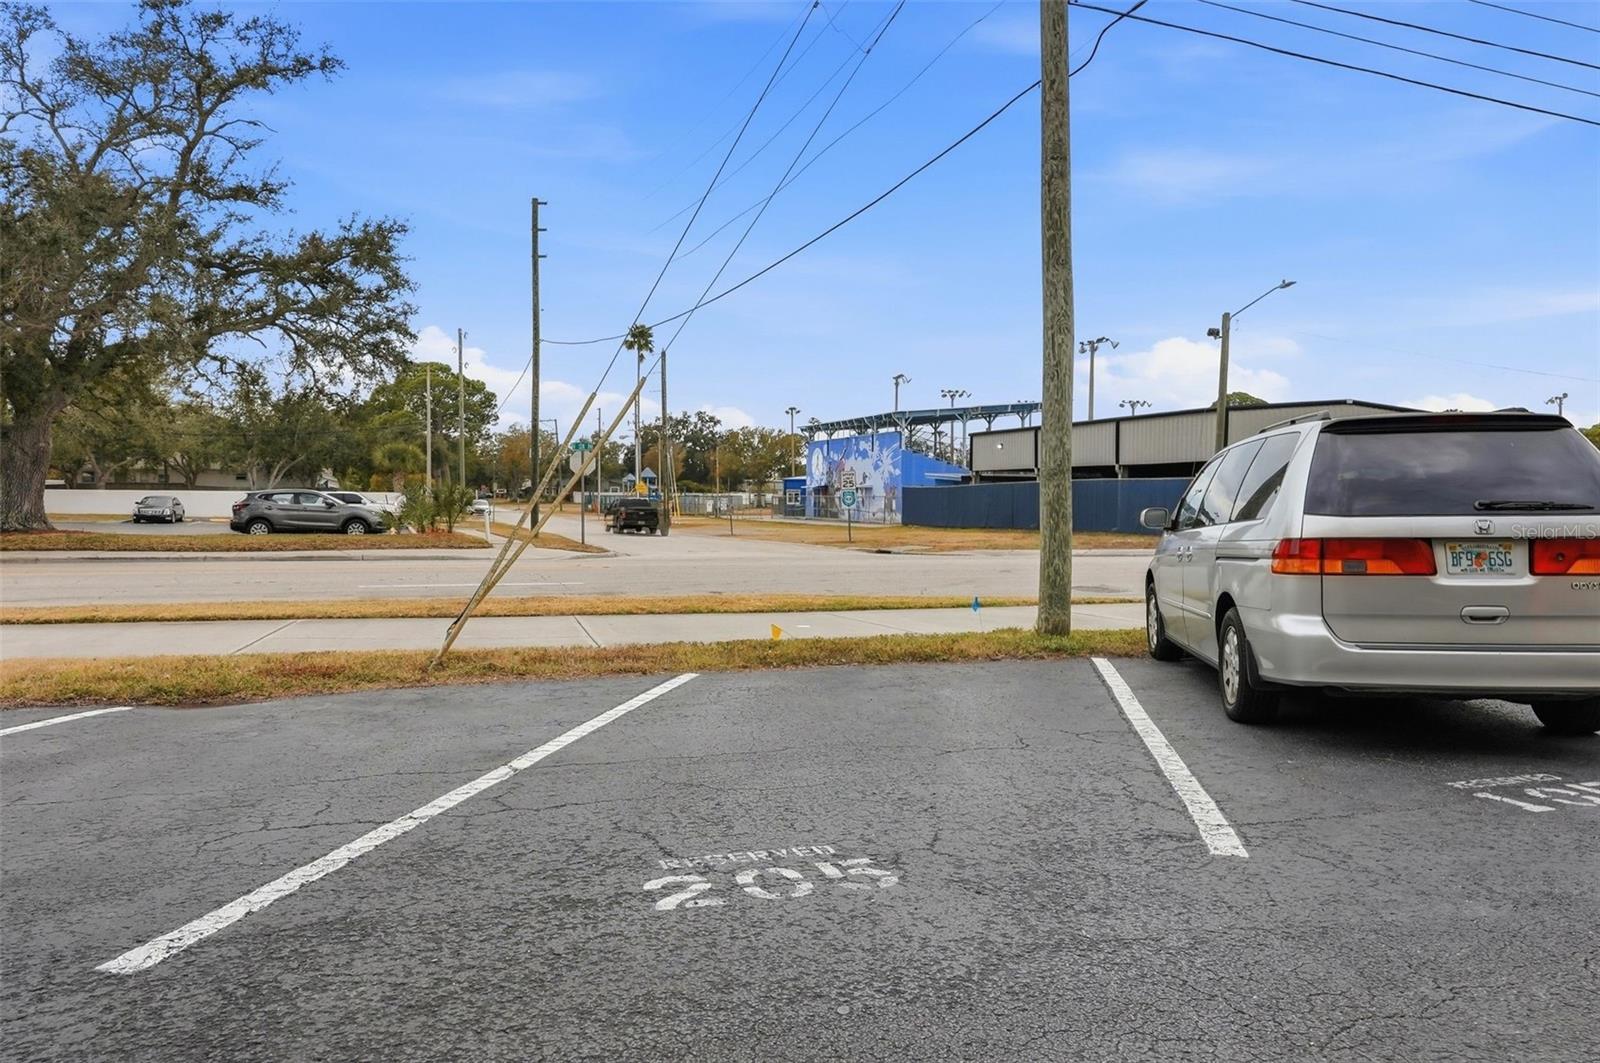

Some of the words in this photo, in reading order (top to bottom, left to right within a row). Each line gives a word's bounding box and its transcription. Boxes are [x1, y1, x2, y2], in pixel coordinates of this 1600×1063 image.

[1451, 551, 1473, 567] BF9
[1488, 551, 1513, 567] 6SG
[1570, 581, 1600, 590] ODYS
